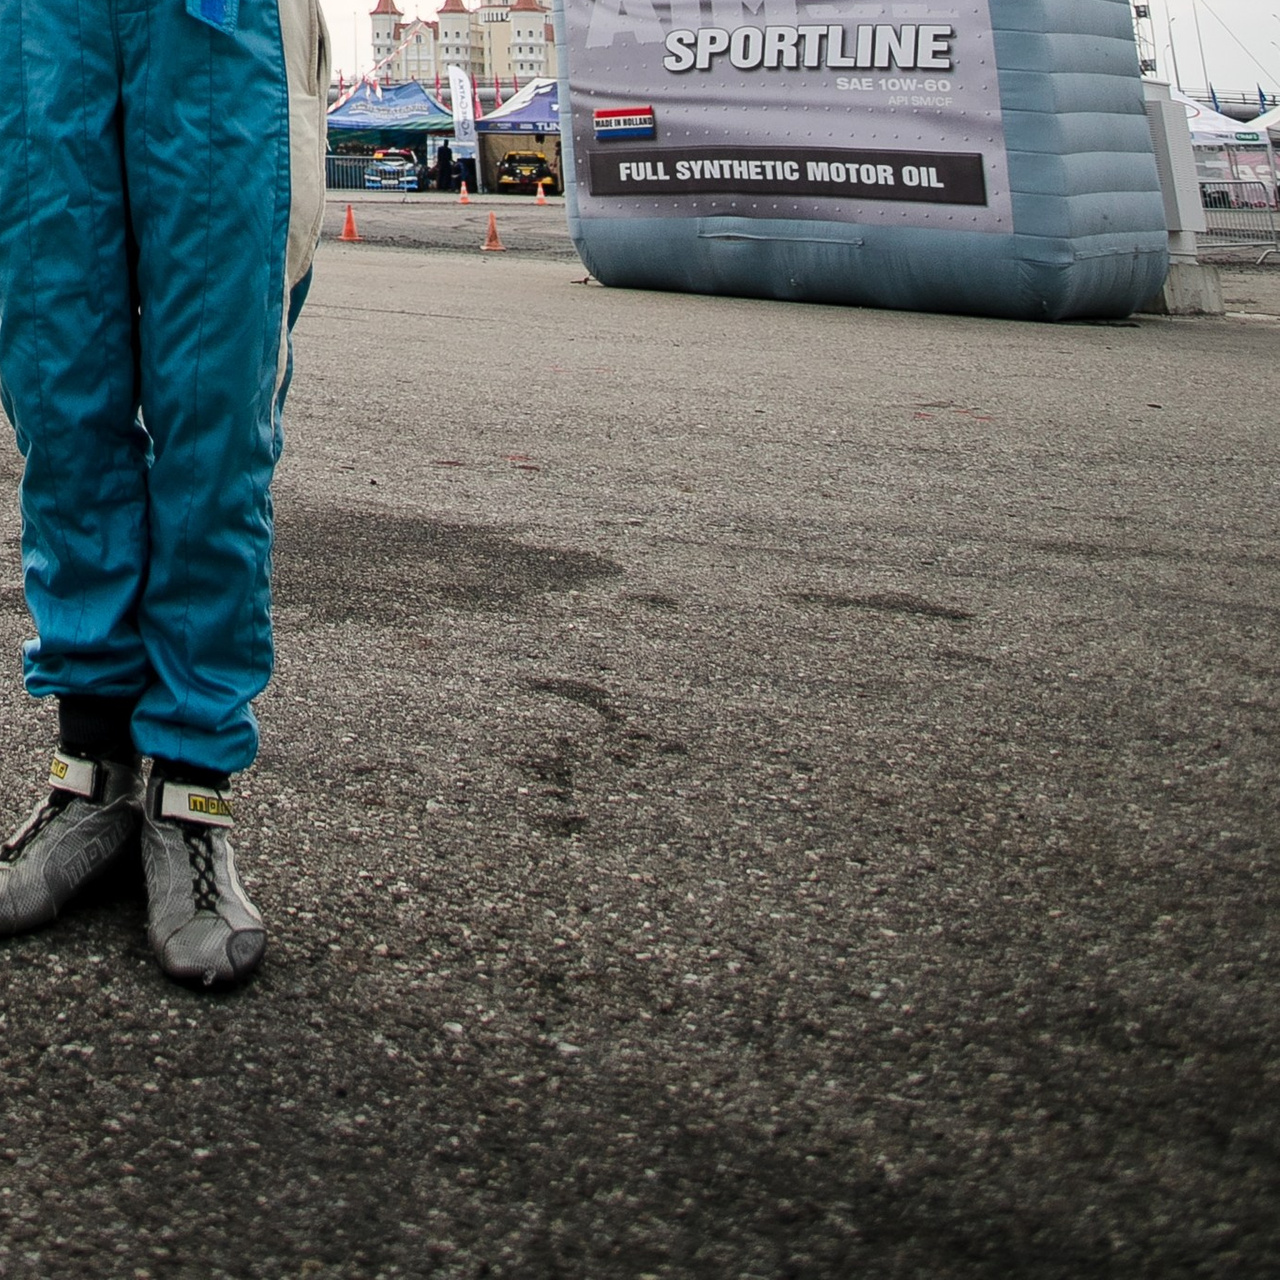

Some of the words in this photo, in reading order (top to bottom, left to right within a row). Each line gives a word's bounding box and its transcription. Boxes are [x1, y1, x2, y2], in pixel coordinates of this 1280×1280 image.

[663, 24, 953, 72] SPORTLINE
[836, 78, 873, 91] SAE
[878, 78, 951, 92] 10W-60
[887, 95, 910, 106] API
[912, 95, 954, 107] SM/CF
[594, 117, 613, 128] MADE
[614, 117, 621, 127] IN
[622, 115, 653, 127] HOLLAND
[620, 162, 670, 182] FULL
[676, 160, 800, 181] SYNTHETIC
[807, 161, 895, 186] MOTOR
[902, 165, 945, 188] OIL
